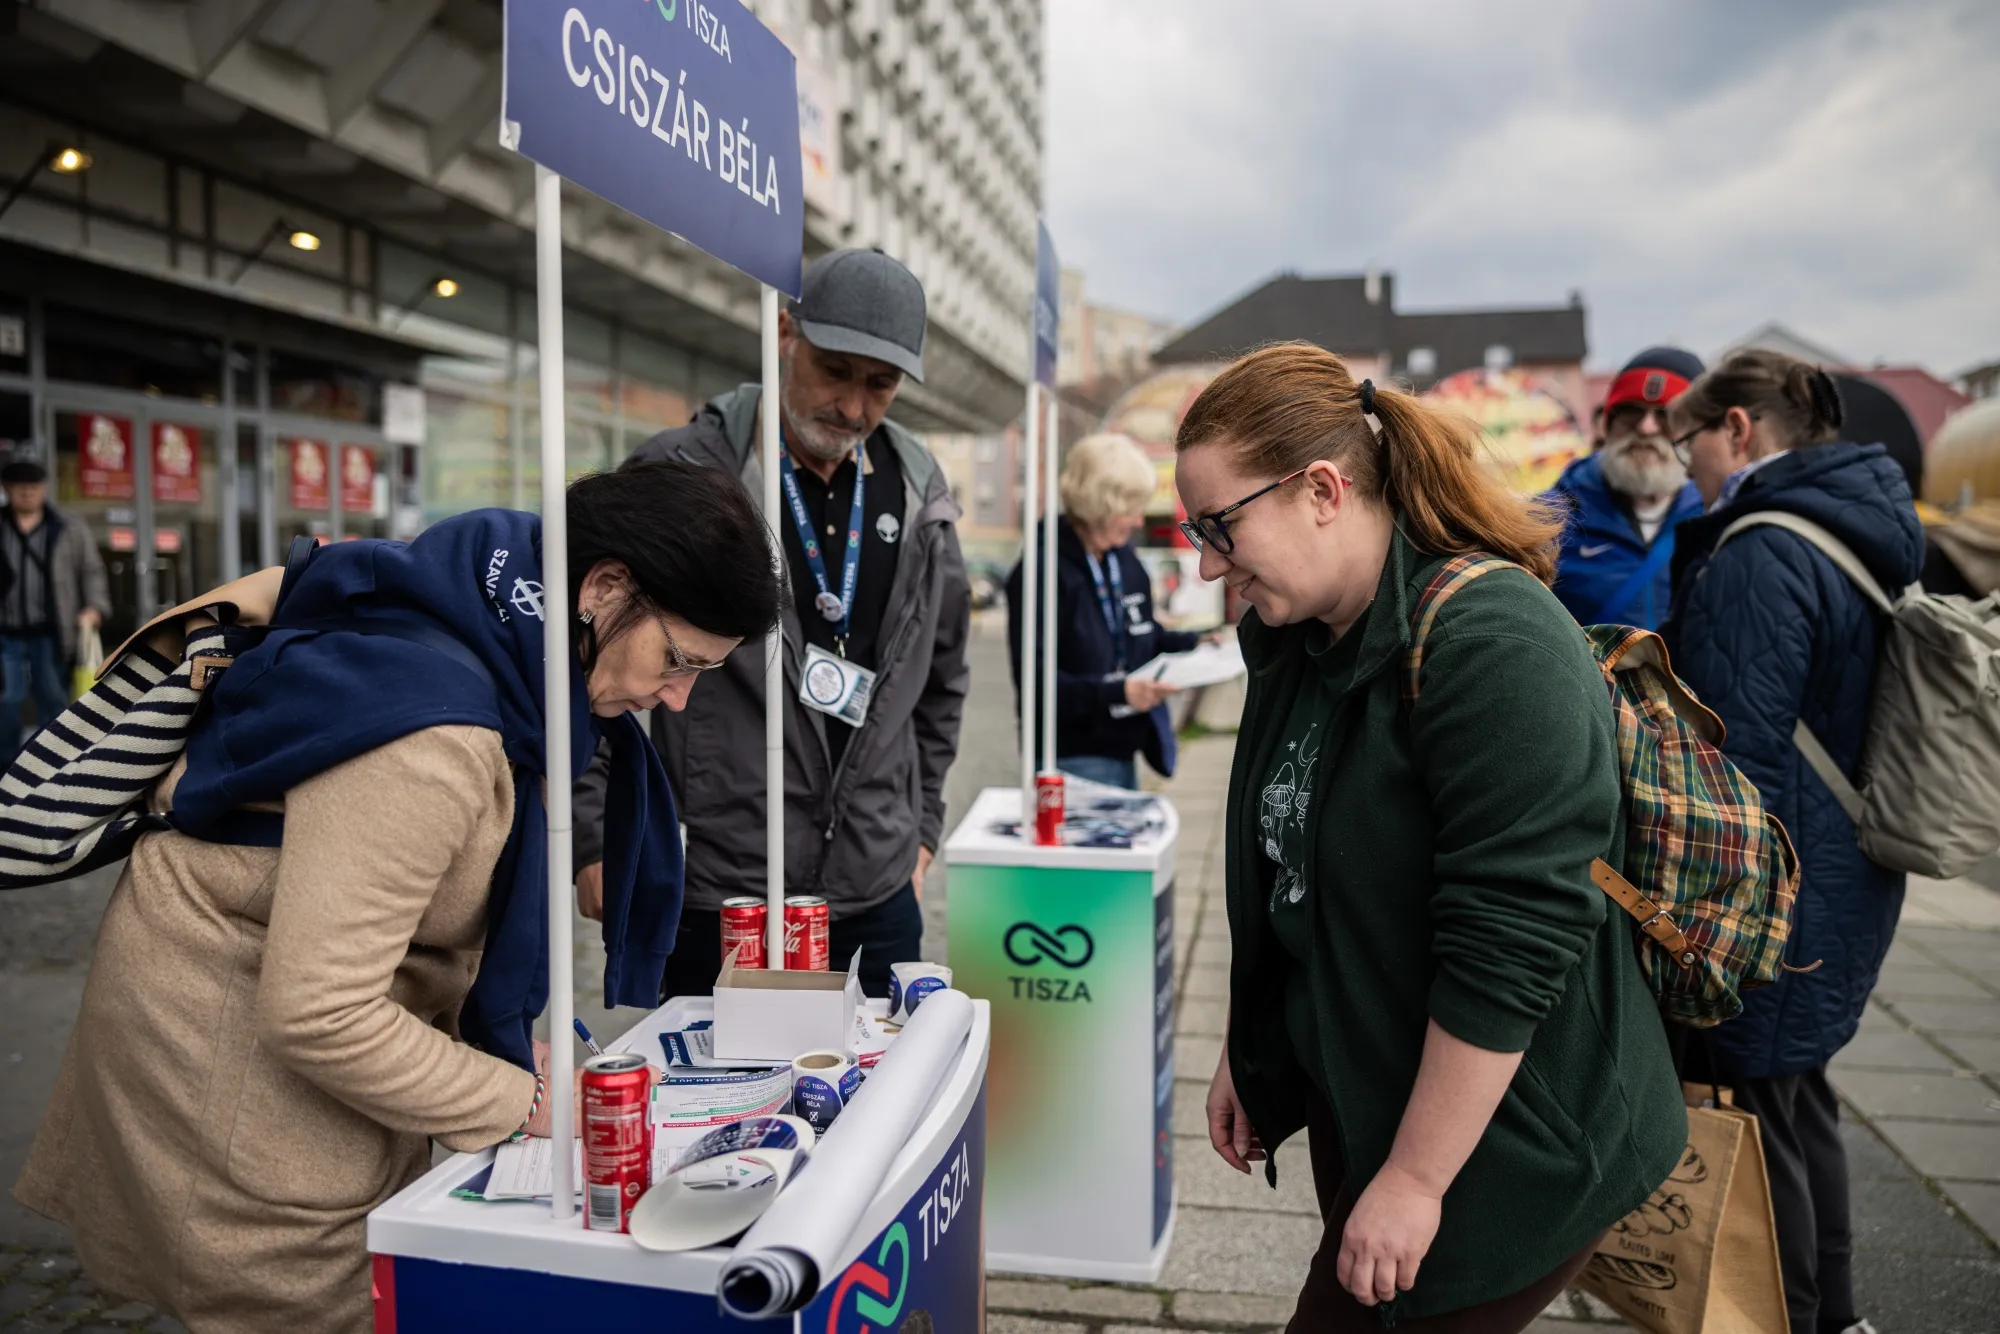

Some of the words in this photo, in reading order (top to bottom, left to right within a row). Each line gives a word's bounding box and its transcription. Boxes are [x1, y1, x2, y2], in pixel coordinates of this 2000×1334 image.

[562, 7, 711, 171] CSISZÁR
[719, 117, 781, 215] BÉLA
[1008, 976, 1092, 1003] TISZA
[802, 1092, 826, 1101] CSISZÁR
[919, 1141, 970, 1262] TISZA
